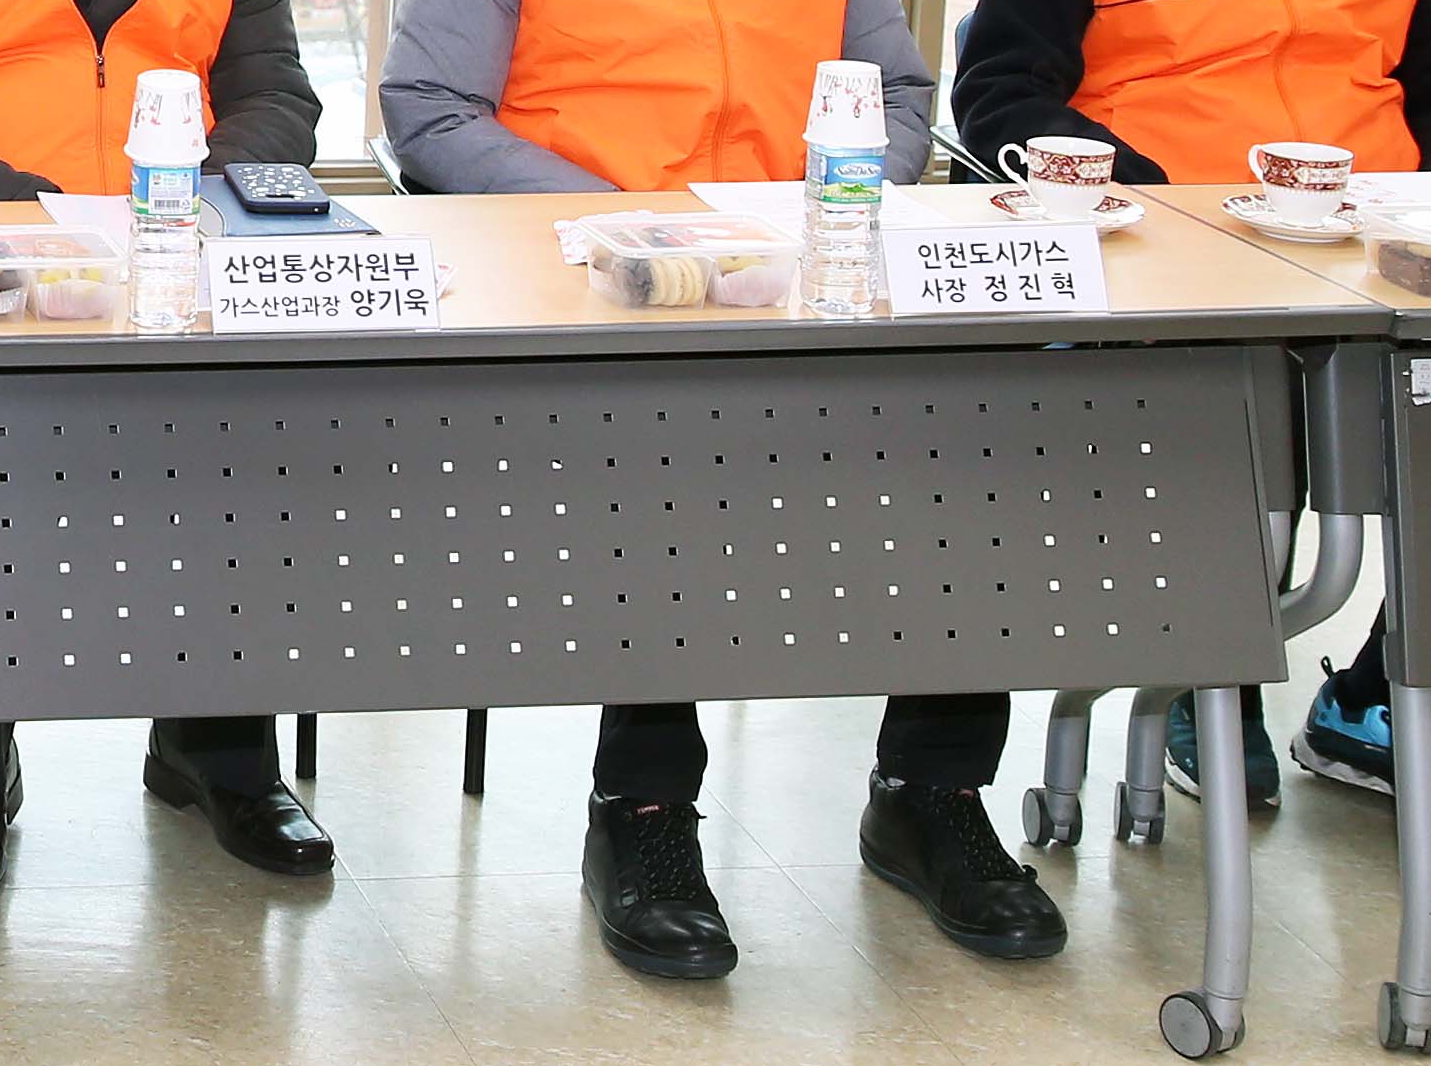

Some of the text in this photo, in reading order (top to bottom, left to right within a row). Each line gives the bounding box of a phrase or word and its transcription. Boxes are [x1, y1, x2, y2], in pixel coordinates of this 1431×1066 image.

[224, 253, 419, 283] 산업통상자원부
[918, 241, 1069, 269] 인천도시가스
[221, 289, 429, 317] 가스산업과장 양기욱
[922, 278, 966, 303] 사장
